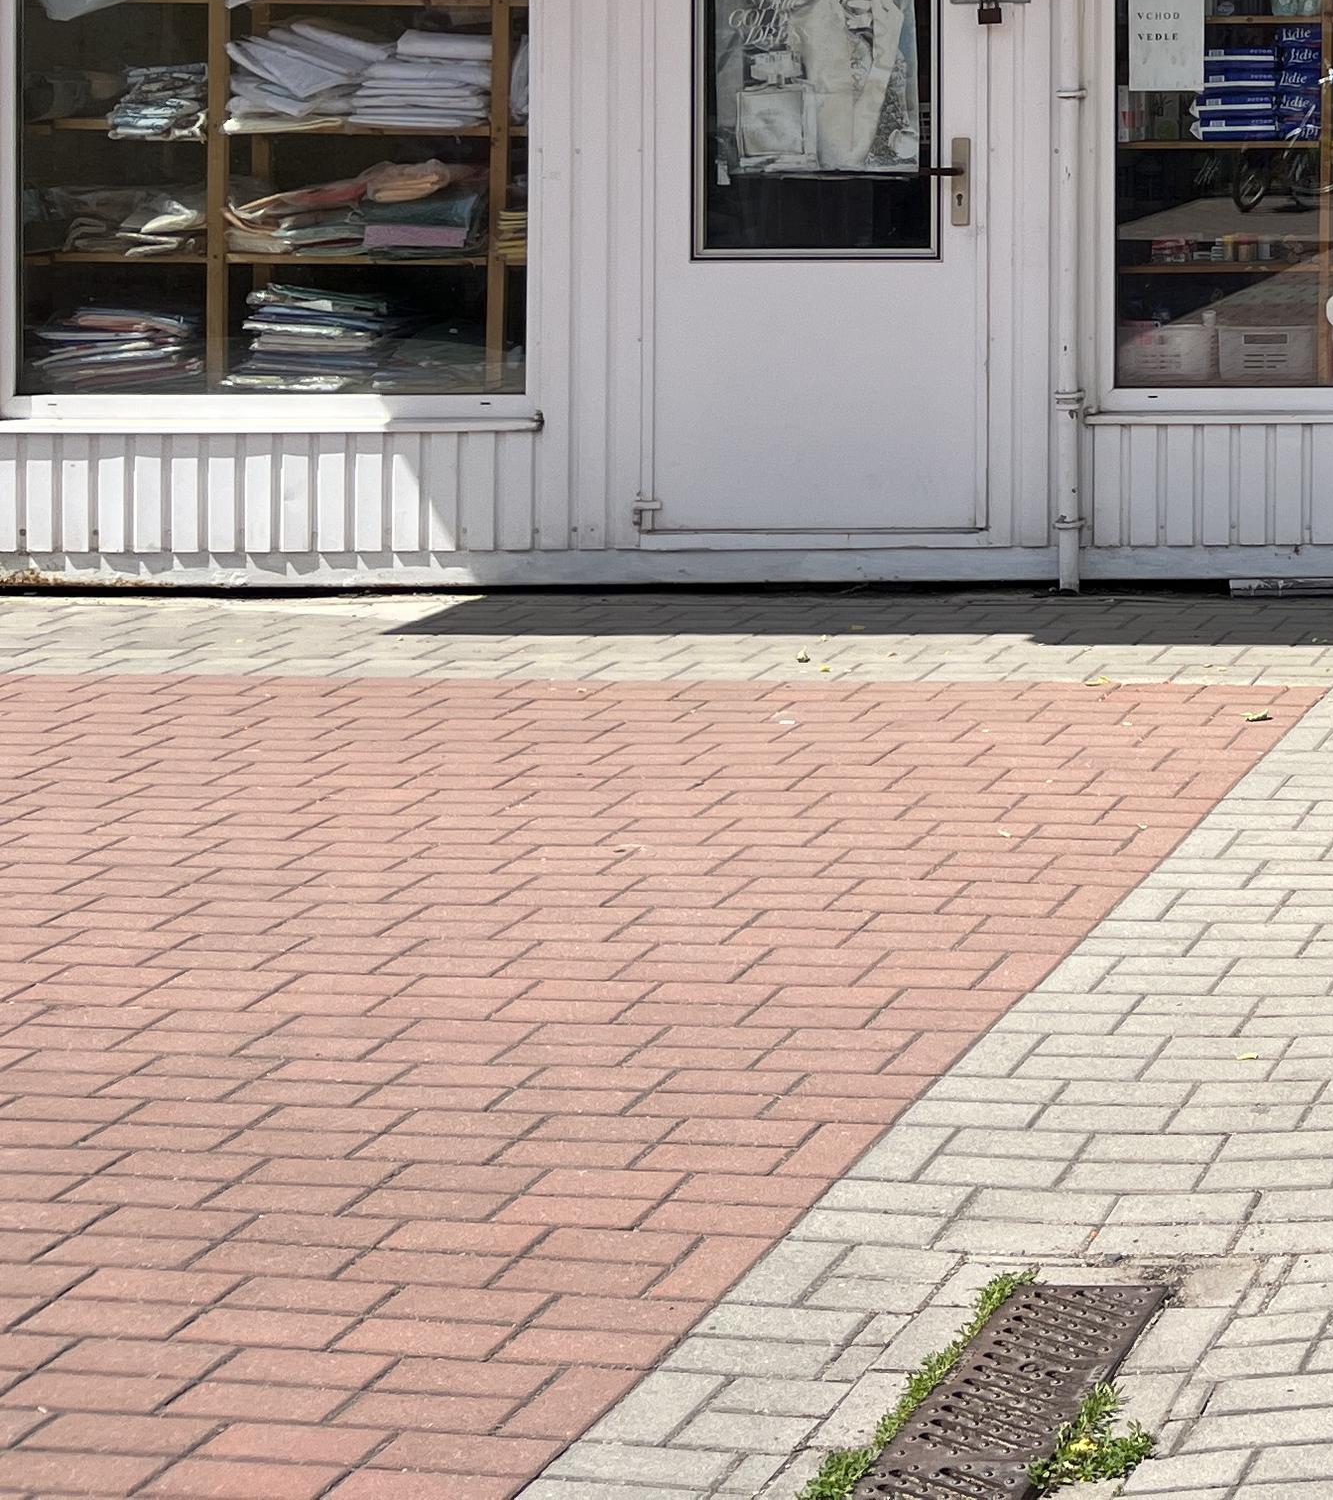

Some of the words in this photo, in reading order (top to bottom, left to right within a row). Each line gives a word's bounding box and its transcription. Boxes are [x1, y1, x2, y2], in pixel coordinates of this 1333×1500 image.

[1137, 12, 1181, 21] VCHOD
[1137, 32, 1179, 41] VEDLE
[1282, 27, 1312, 41] Lidie
[1288, 48, 1319, 63] Lidie
[1280, 71, 1308, 87] Lidie
[1280, 94, 1311, 112] Lidie
